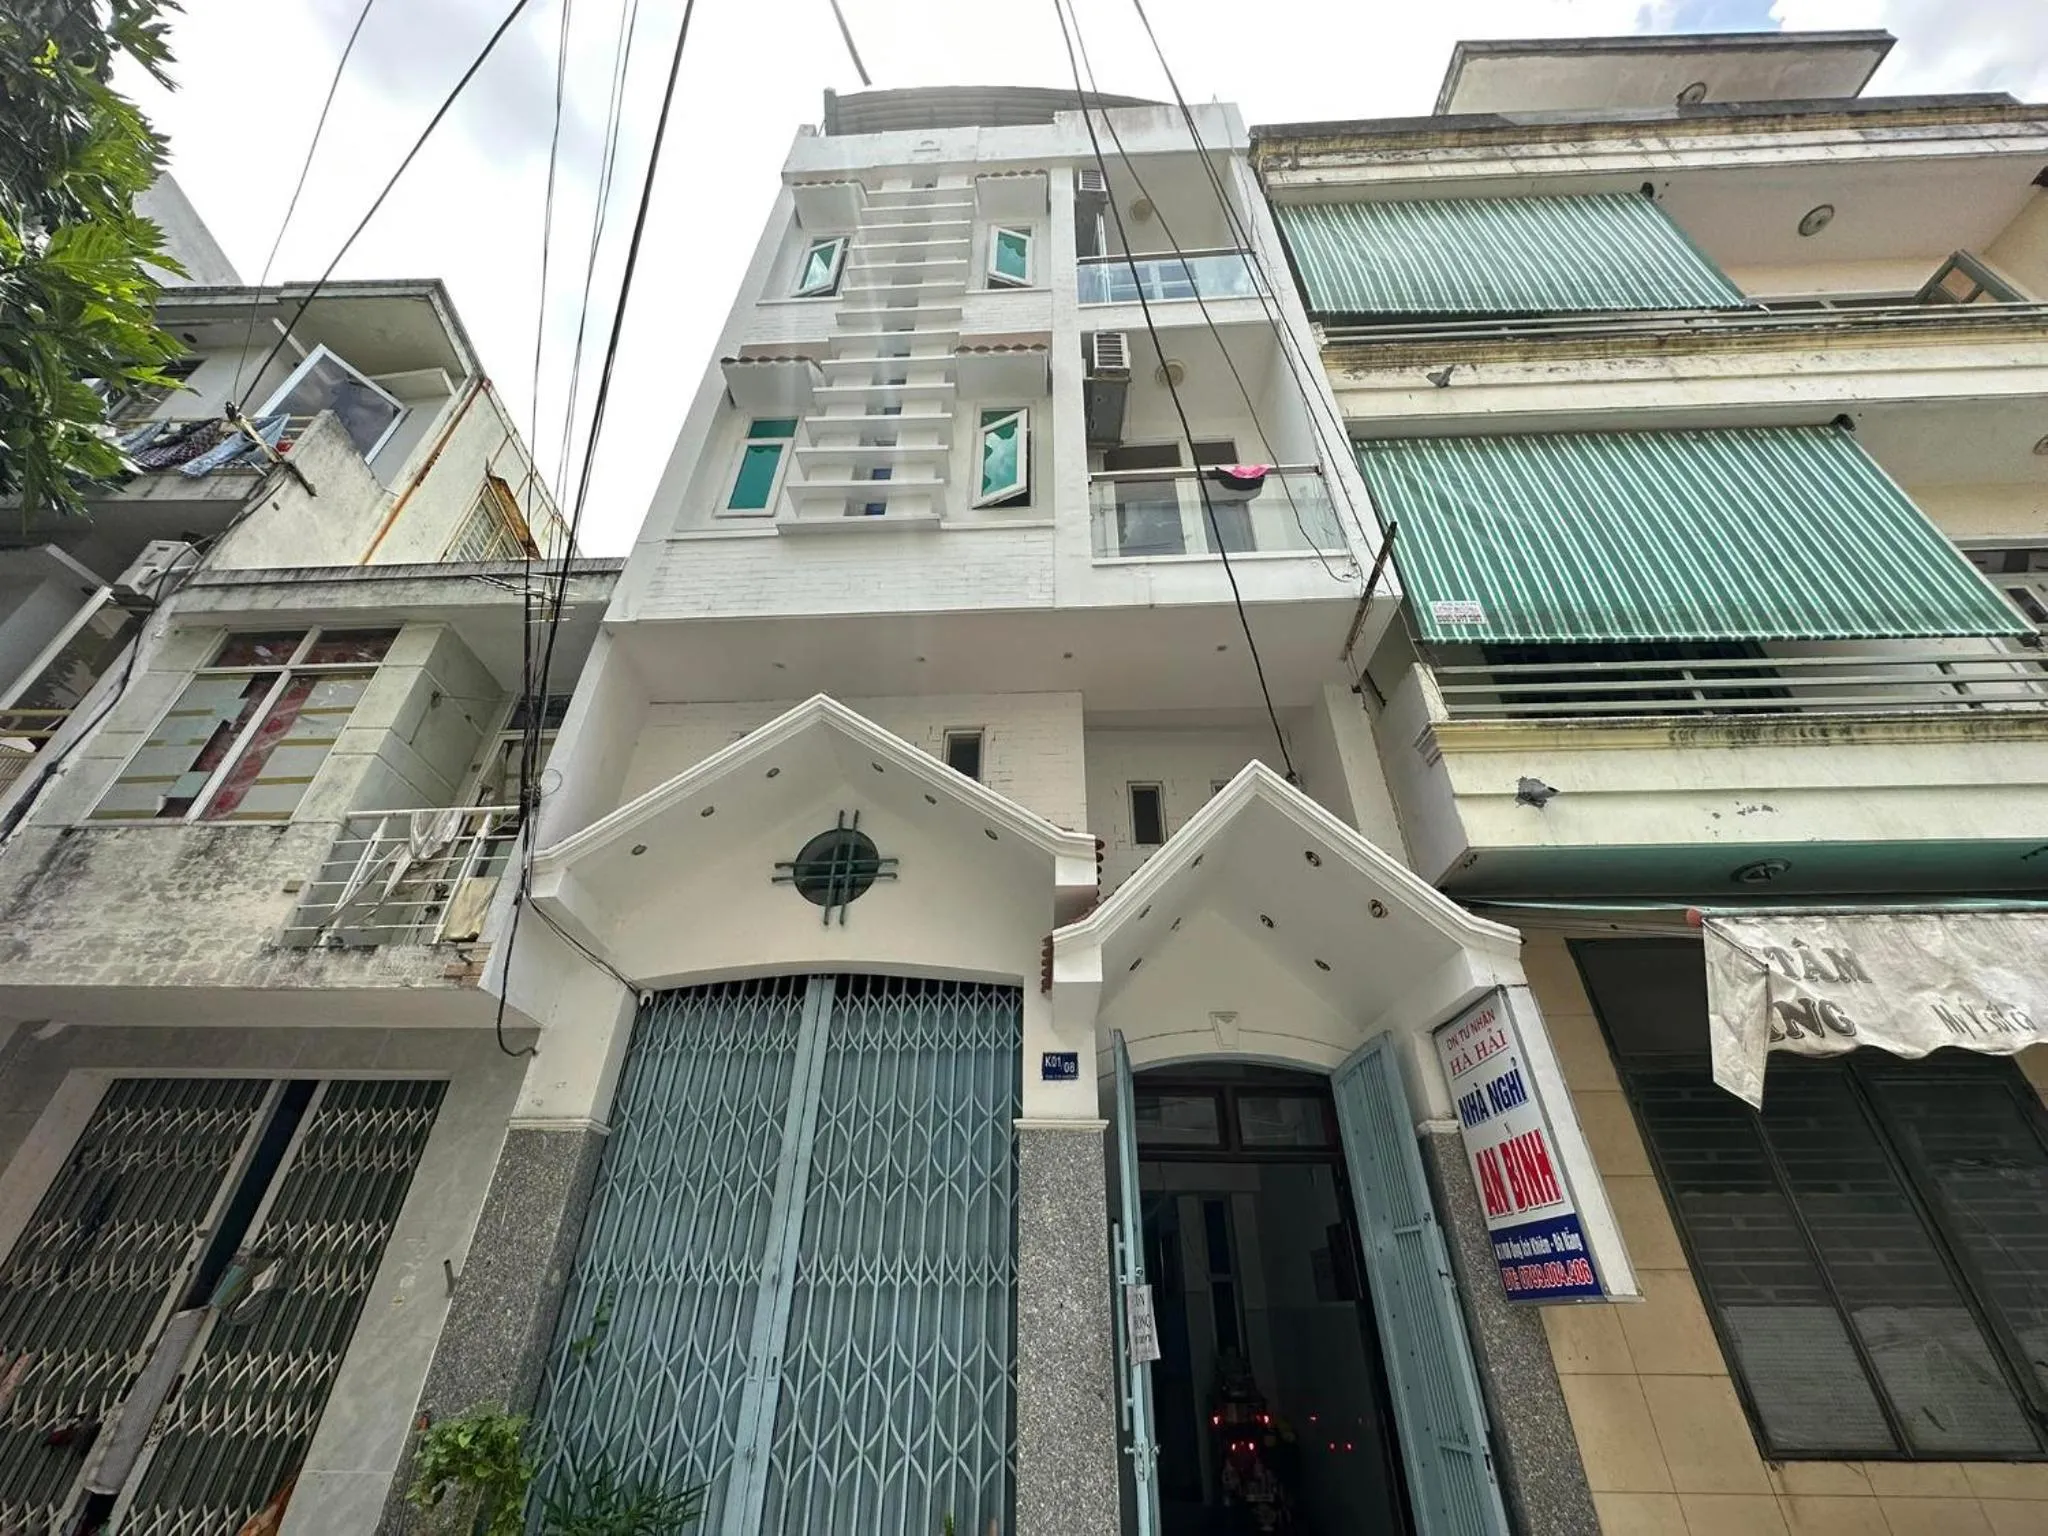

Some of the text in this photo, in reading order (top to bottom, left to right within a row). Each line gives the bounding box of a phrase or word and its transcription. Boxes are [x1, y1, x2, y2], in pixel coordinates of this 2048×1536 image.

[1450, 1048, 1474, 1077] HÀ
[1457, 1057, 1528, 1129] NHÀ NGHỈ
[1475, 1122, 1563, 1217] AN BÌNH
